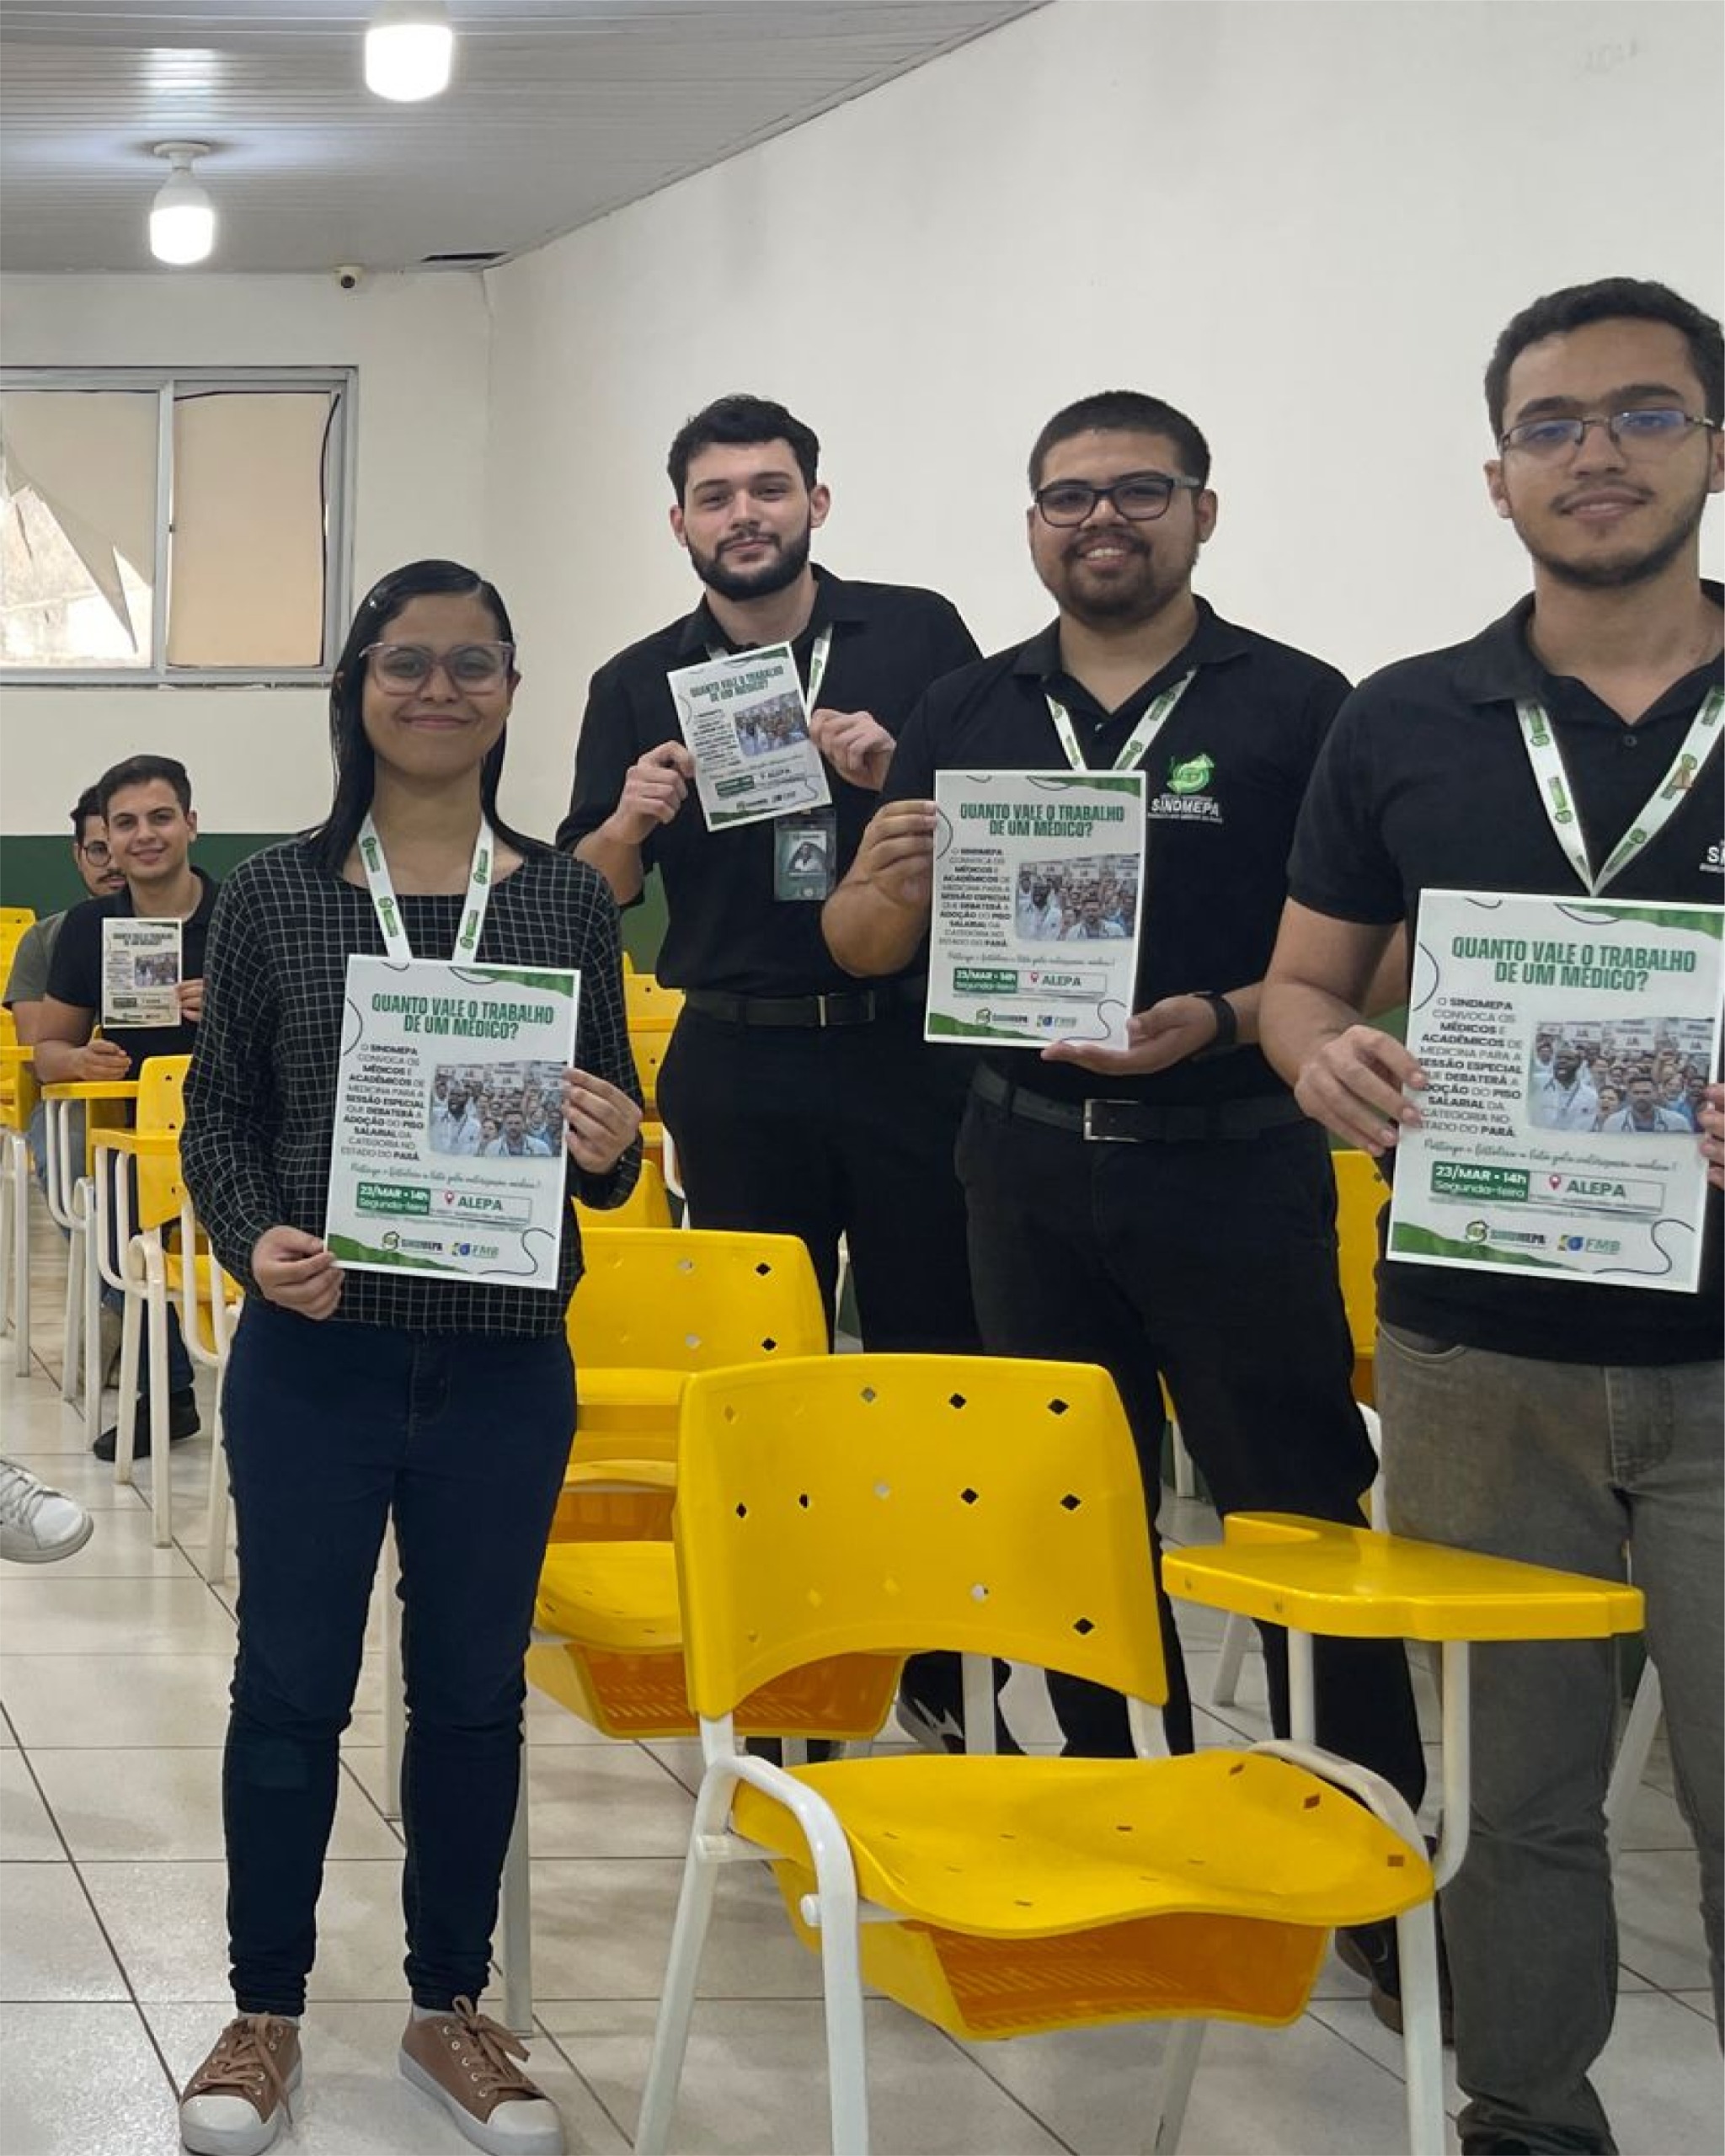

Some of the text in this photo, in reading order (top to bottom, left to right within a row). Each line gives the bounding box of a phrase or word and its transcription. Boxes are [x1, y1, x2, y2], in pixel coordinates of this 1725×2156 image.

[960, 803, 1124, 823] QUANTO VALE O TRABALHO
[1151, 798, 1219, 816] SINDMEPA
[990, 819, 1092, 837] DE UM MÉDICO?
[1451, 937, 1696, 973] QUANTO VALE O TRABALHO
[1042, 974, 1081, 986] ALEPA
[1494, 961, 1649, 992] DE UM MÉDICO?
[371, 993, 554, 1025] QUANTO VALE O TRABALHO
[1437, 997, 1513, 1010] O SINDMEPA
[1432, 1010, 1515, 1023] CONVOCA OS
[403, 1014, 519, 1039] DE UM MÉDICO?
[1439, 1021, 1497, 1034] MÉDICOS
[1422, 1033, 1522, 1049] ACADÊMICOS DE
[1420, 1045, 1476, 1058] MEDICINA
[1479, 1051, 1509, 1060] PARA
[1466, 1061, 1522, 1074] ESPECIAL
[1445, 1071, 1508, 1085] DEBATERÁ
[1510, 1078, 1519, 1086] A
[1471, 1086, 1491, 1097] DO
[1493, 1088, 1521, 1100] PISO
[1429, 1096, 1504, 1110] SALARIAL DA
[1490, 1113, 1509, 1123] NO
[1460, 1123, 1477, 1134] DO
[1434, 1165, 1527, 1185] 23/MAR 14h
[1566, 1180, 1626, 1198] ALEPA
[457, 1195, 504, 1211] ALEPA
[1585, 1239, 1621, 1252] FMB
